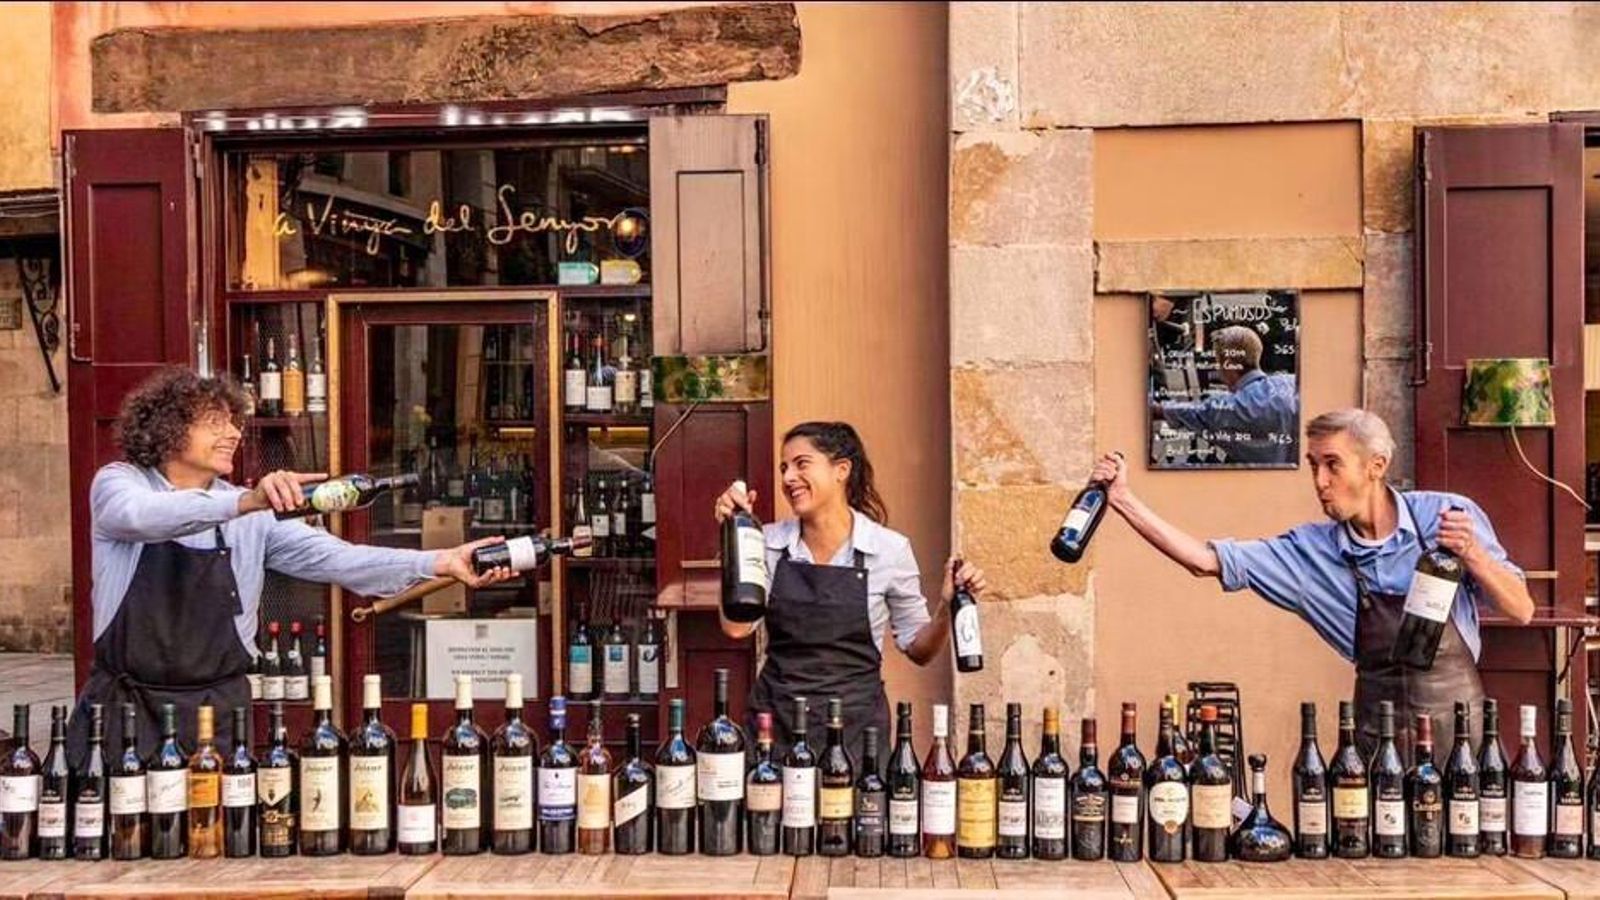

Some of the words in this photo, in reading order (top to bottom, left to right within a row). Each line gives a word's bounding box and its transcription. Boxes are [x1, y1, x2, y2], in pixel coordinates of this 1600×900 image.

[307, 194, 412, 255] Vinya
[423, 200, 475, 234] del
[487, 184, 626, 254] Senyor
